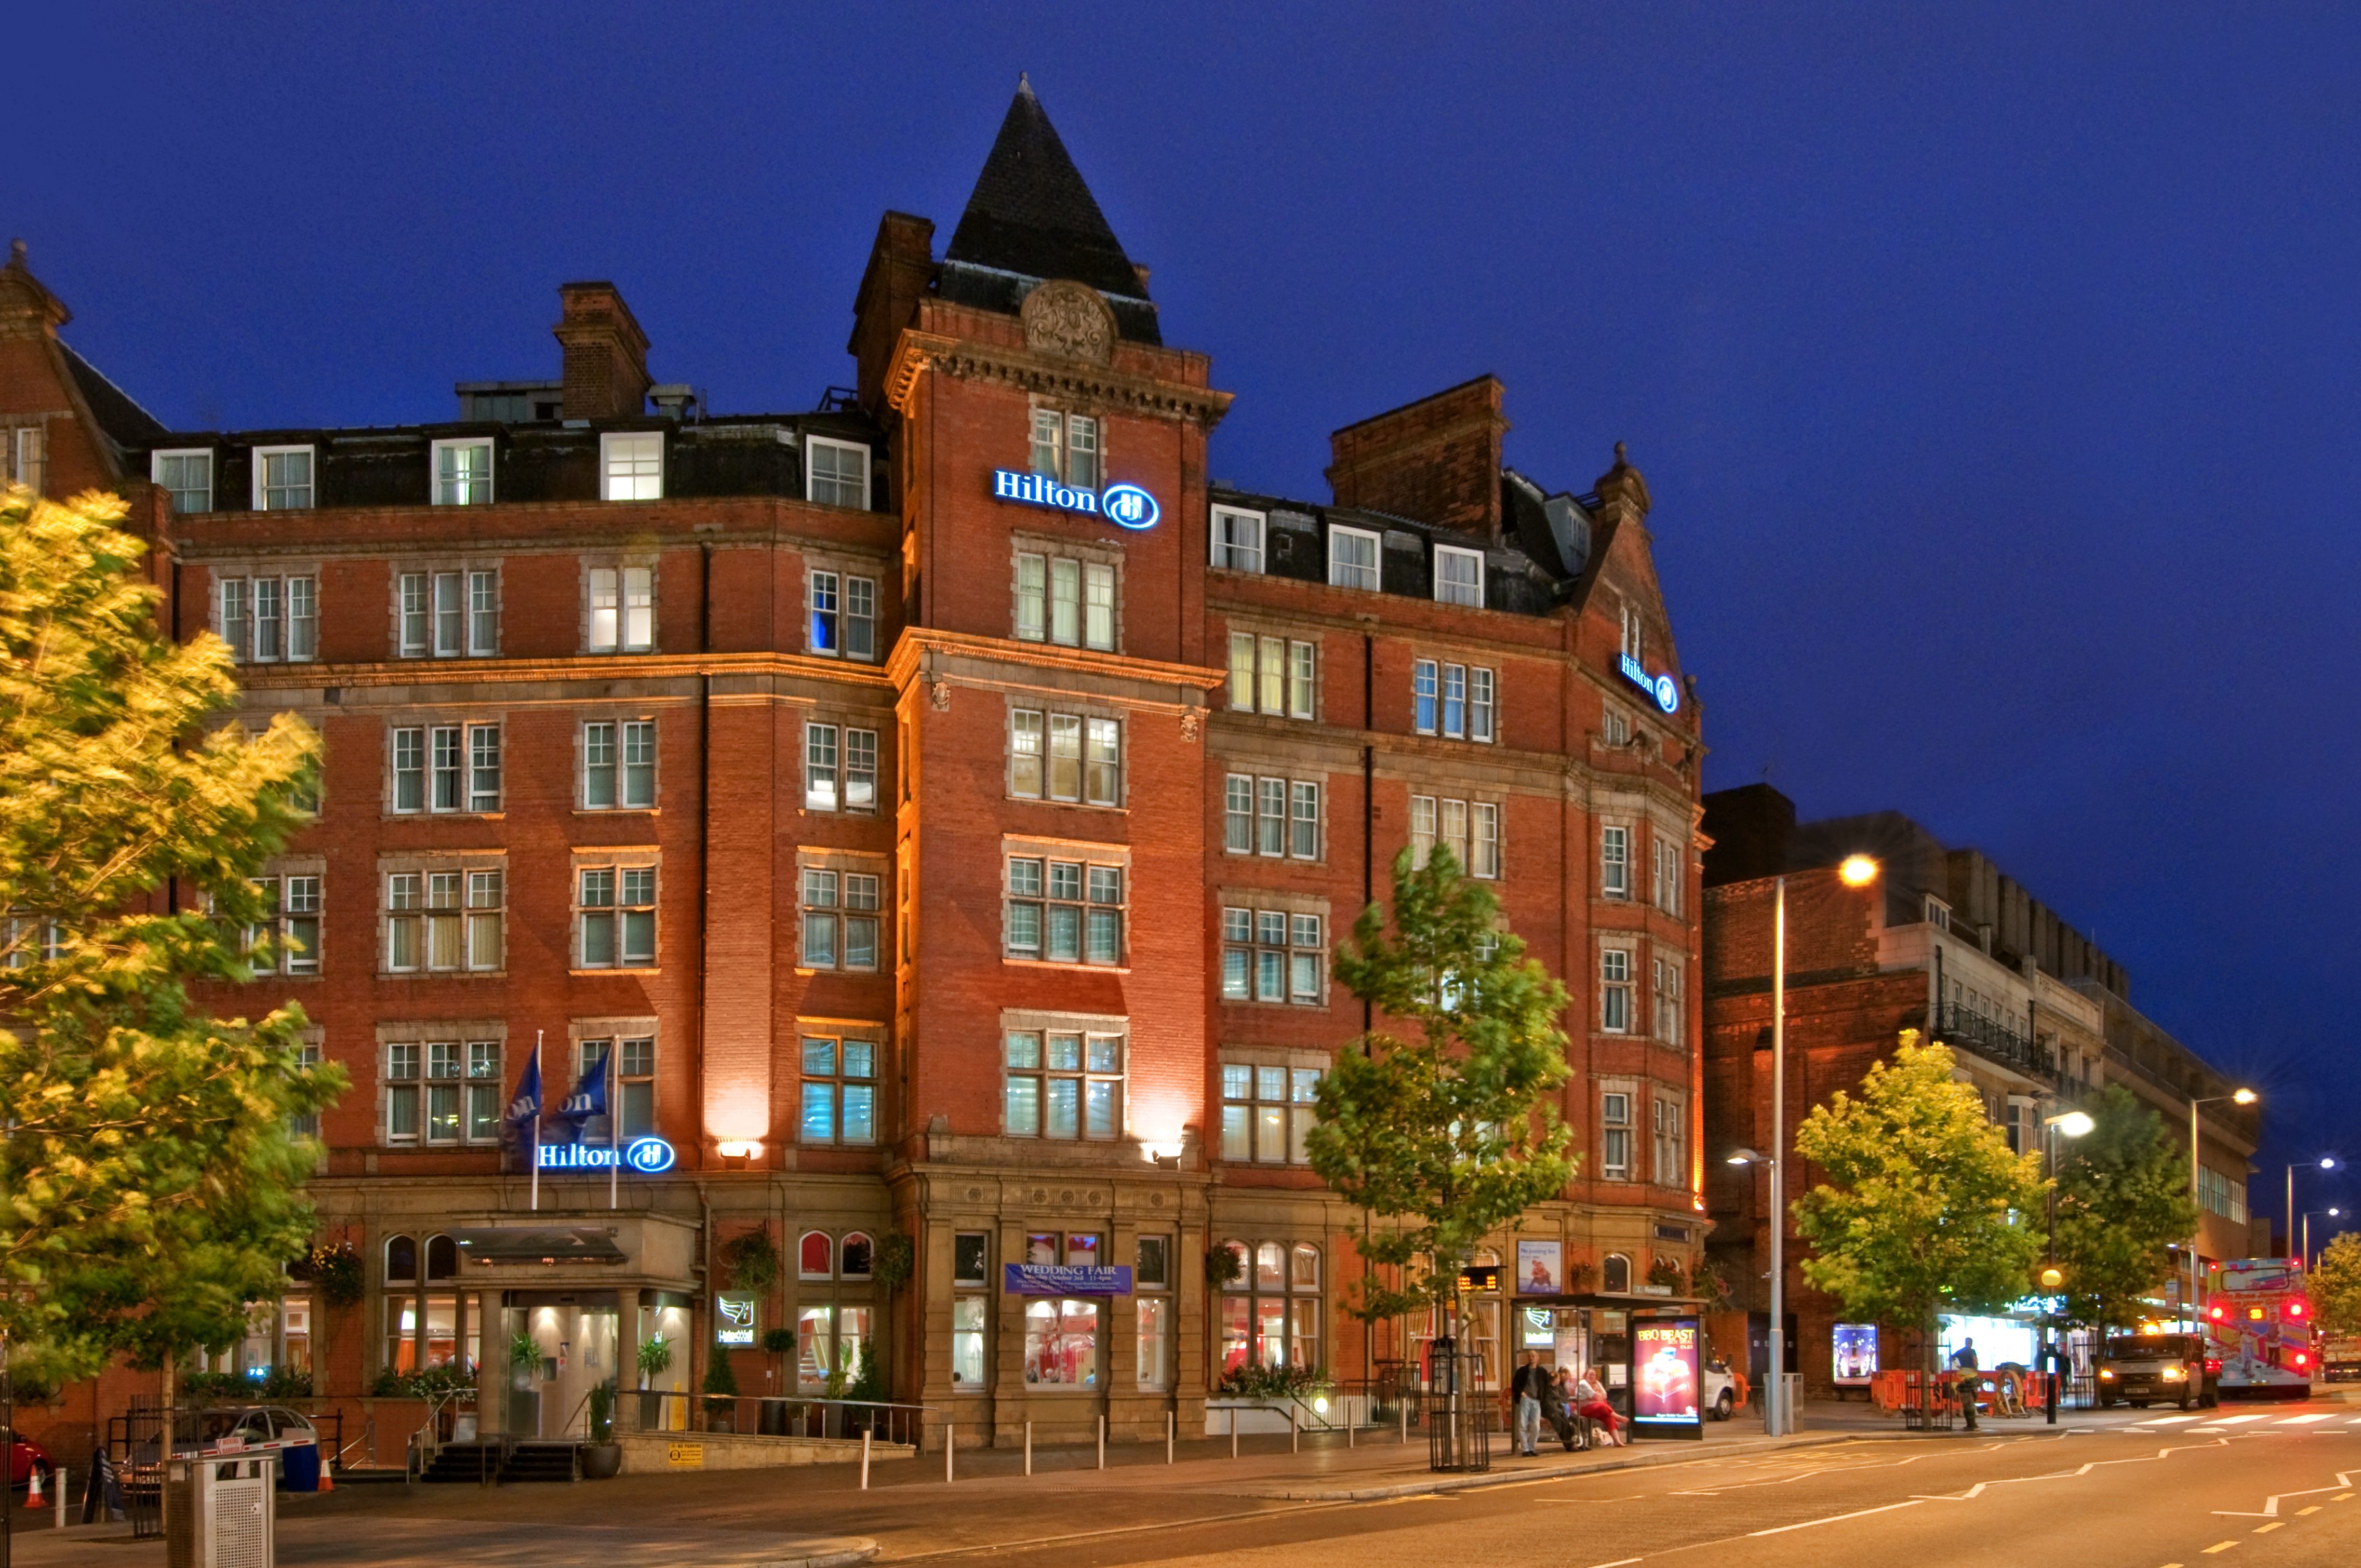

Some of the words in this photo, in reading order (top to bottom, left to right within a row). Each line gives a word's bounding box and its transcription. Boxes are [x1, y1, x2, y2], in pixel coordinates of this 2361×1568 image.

[995, 470, 1098, 512] Hilton
[1621, 653, 1654, 694] Hilton
[538, 1143, 621, 1167] Hilton
[1020, 1264, 1083, 1275] WEDDING
[1088, 1266, 1118, 1275] FAIR
[1637, 1329, 1659, 1341] BBQ
[1660, 1329, 1695, 1341] BEAST
[222, 1446, 240, 1454] BARRIER
